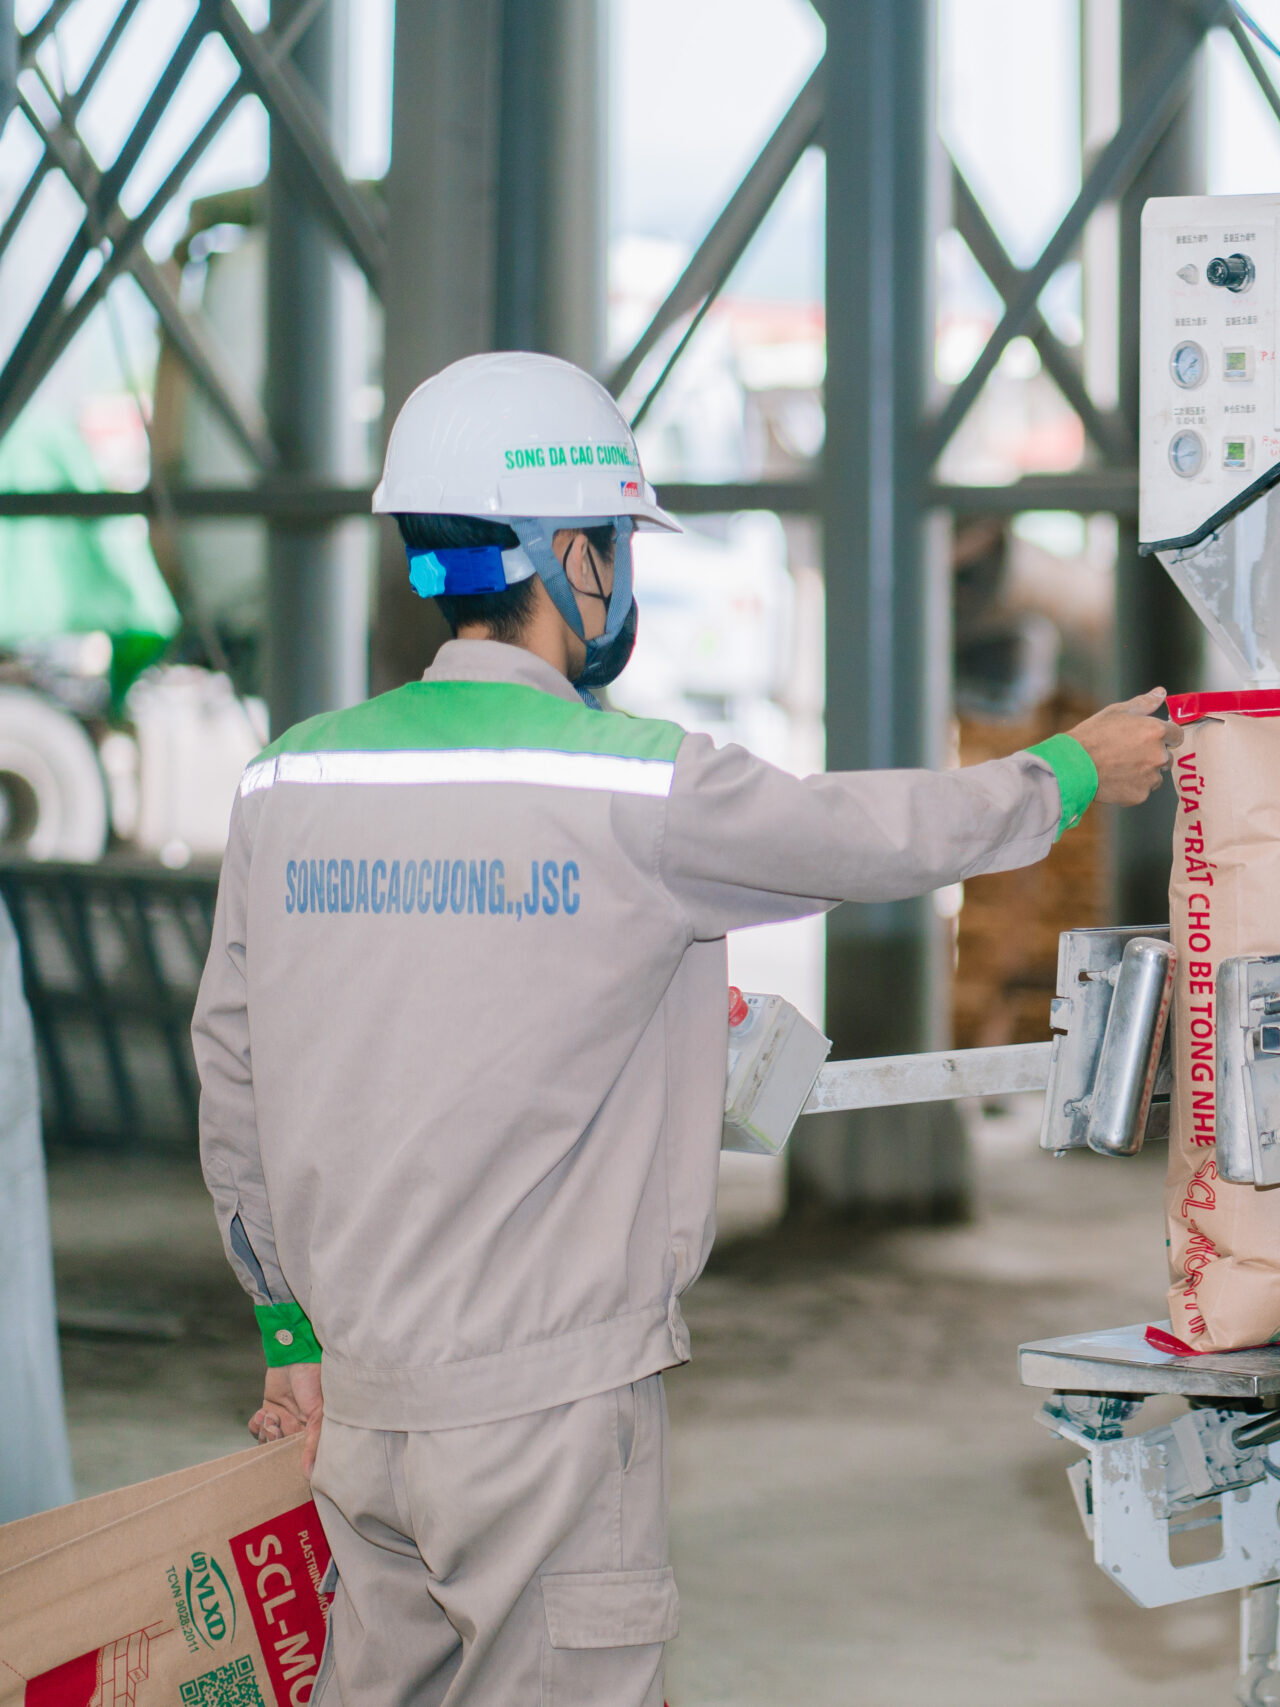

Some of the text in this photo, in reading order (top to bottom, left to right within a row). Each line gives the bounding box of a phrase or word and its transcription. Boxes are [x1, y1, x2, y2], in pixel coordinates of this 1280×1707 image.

[505, 449, 545, 470] SONG
[549, 447, 567, 467] DA
[570, 445, 594, 467] CAO
[1177, 751, 1205, 814] VỮA
[1184, 820, 1217, 887] TRÁT
[1188, 893, 1211, 953] CHO
[165, 1564, 200, 1654] TCVN 9028:2011
[195, 1572, 227, 1641] VLXD
